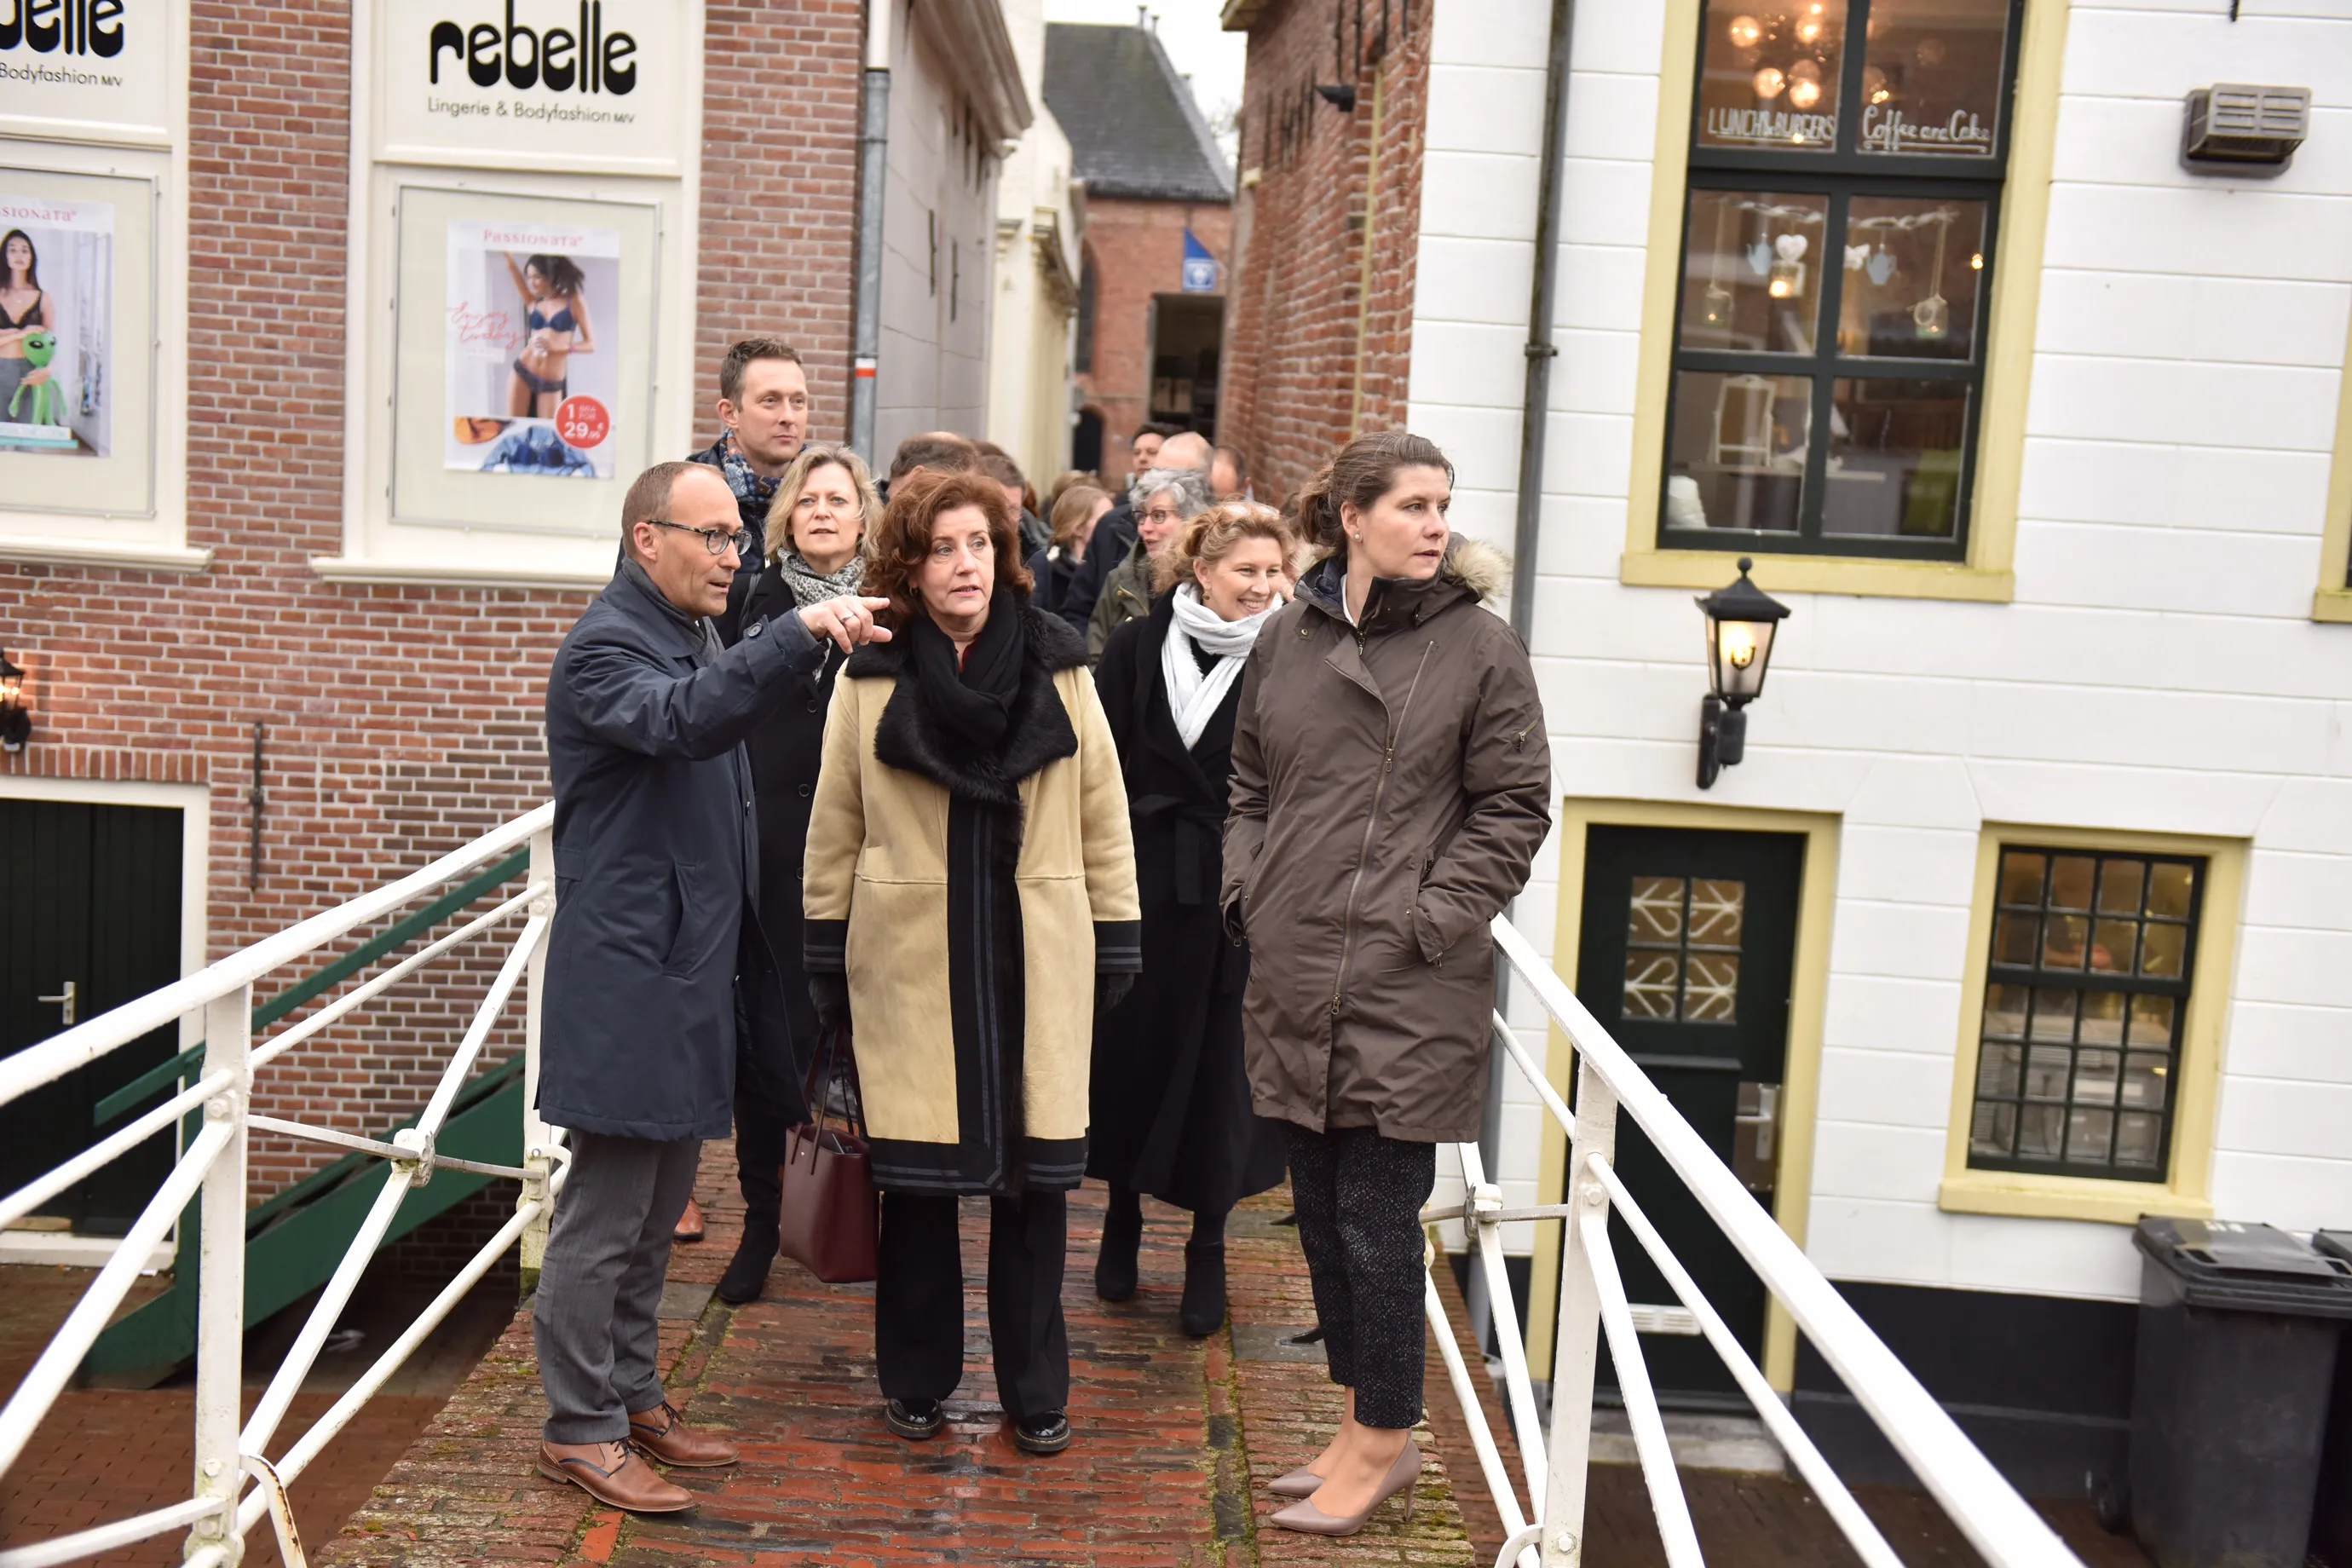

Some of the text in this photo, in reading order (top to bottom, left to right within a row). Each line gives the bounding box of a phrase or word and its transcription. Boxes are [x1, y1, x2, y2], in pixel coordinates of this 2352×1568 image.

[430, 0, 637, 95] rebelle
[428, 96, 490, 117] Lingerie
[496, 101, 508, 116] &
[514, 101, 610, 123] Bodyfashion
[1863, 105, 1917, 151] Coffee
[1950, 109, 1990, 141] Cake
[567, 403, 574, 420] 1
